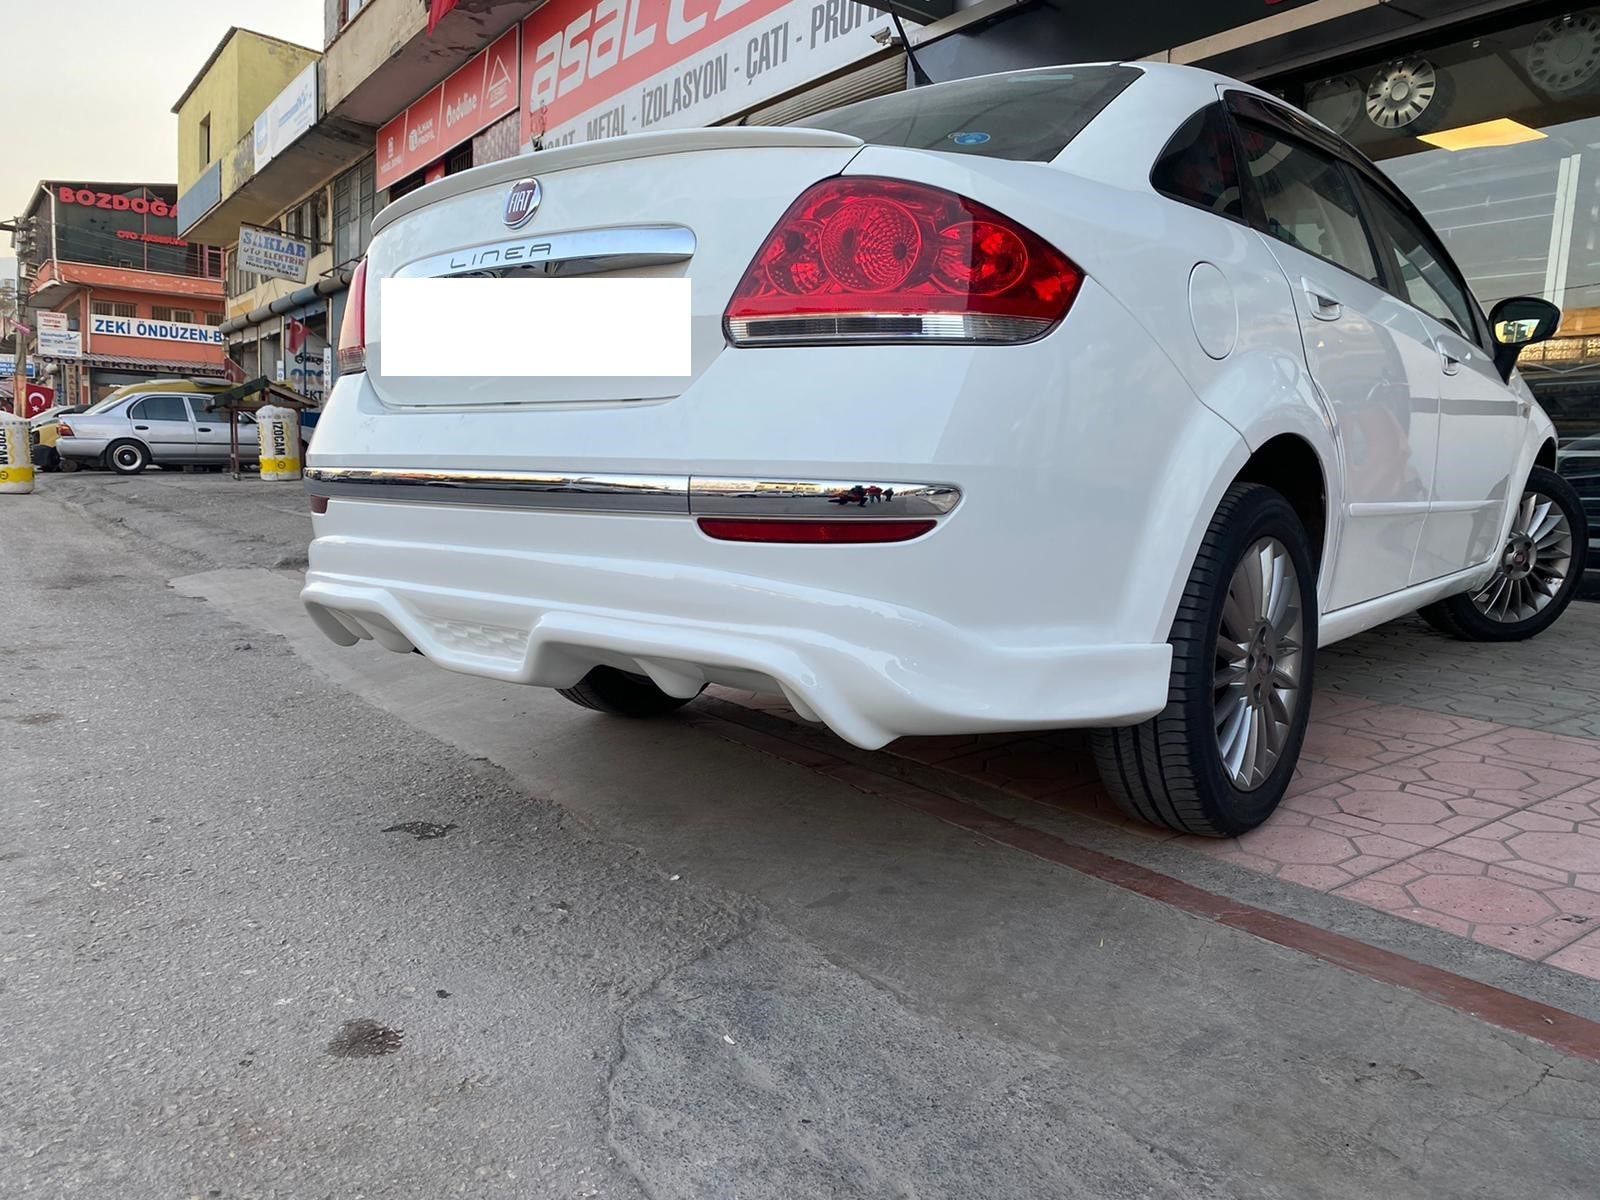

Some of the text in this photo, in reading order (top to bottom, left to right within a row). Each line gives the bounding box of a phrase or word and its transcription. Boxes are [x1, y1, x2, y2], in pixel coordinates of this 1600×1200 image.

[586, 104, 628, 143] METAL
[640, 52, 729, 128] İZOLASYON
[746, 21, 789, 86] ÇATI
[508, 190, 534, 213] FIAT
[450, 242, 552, 269] LINEA
[95, 319, 131, 335] ZEKİ
[43, 356, 76, 365] OTO
